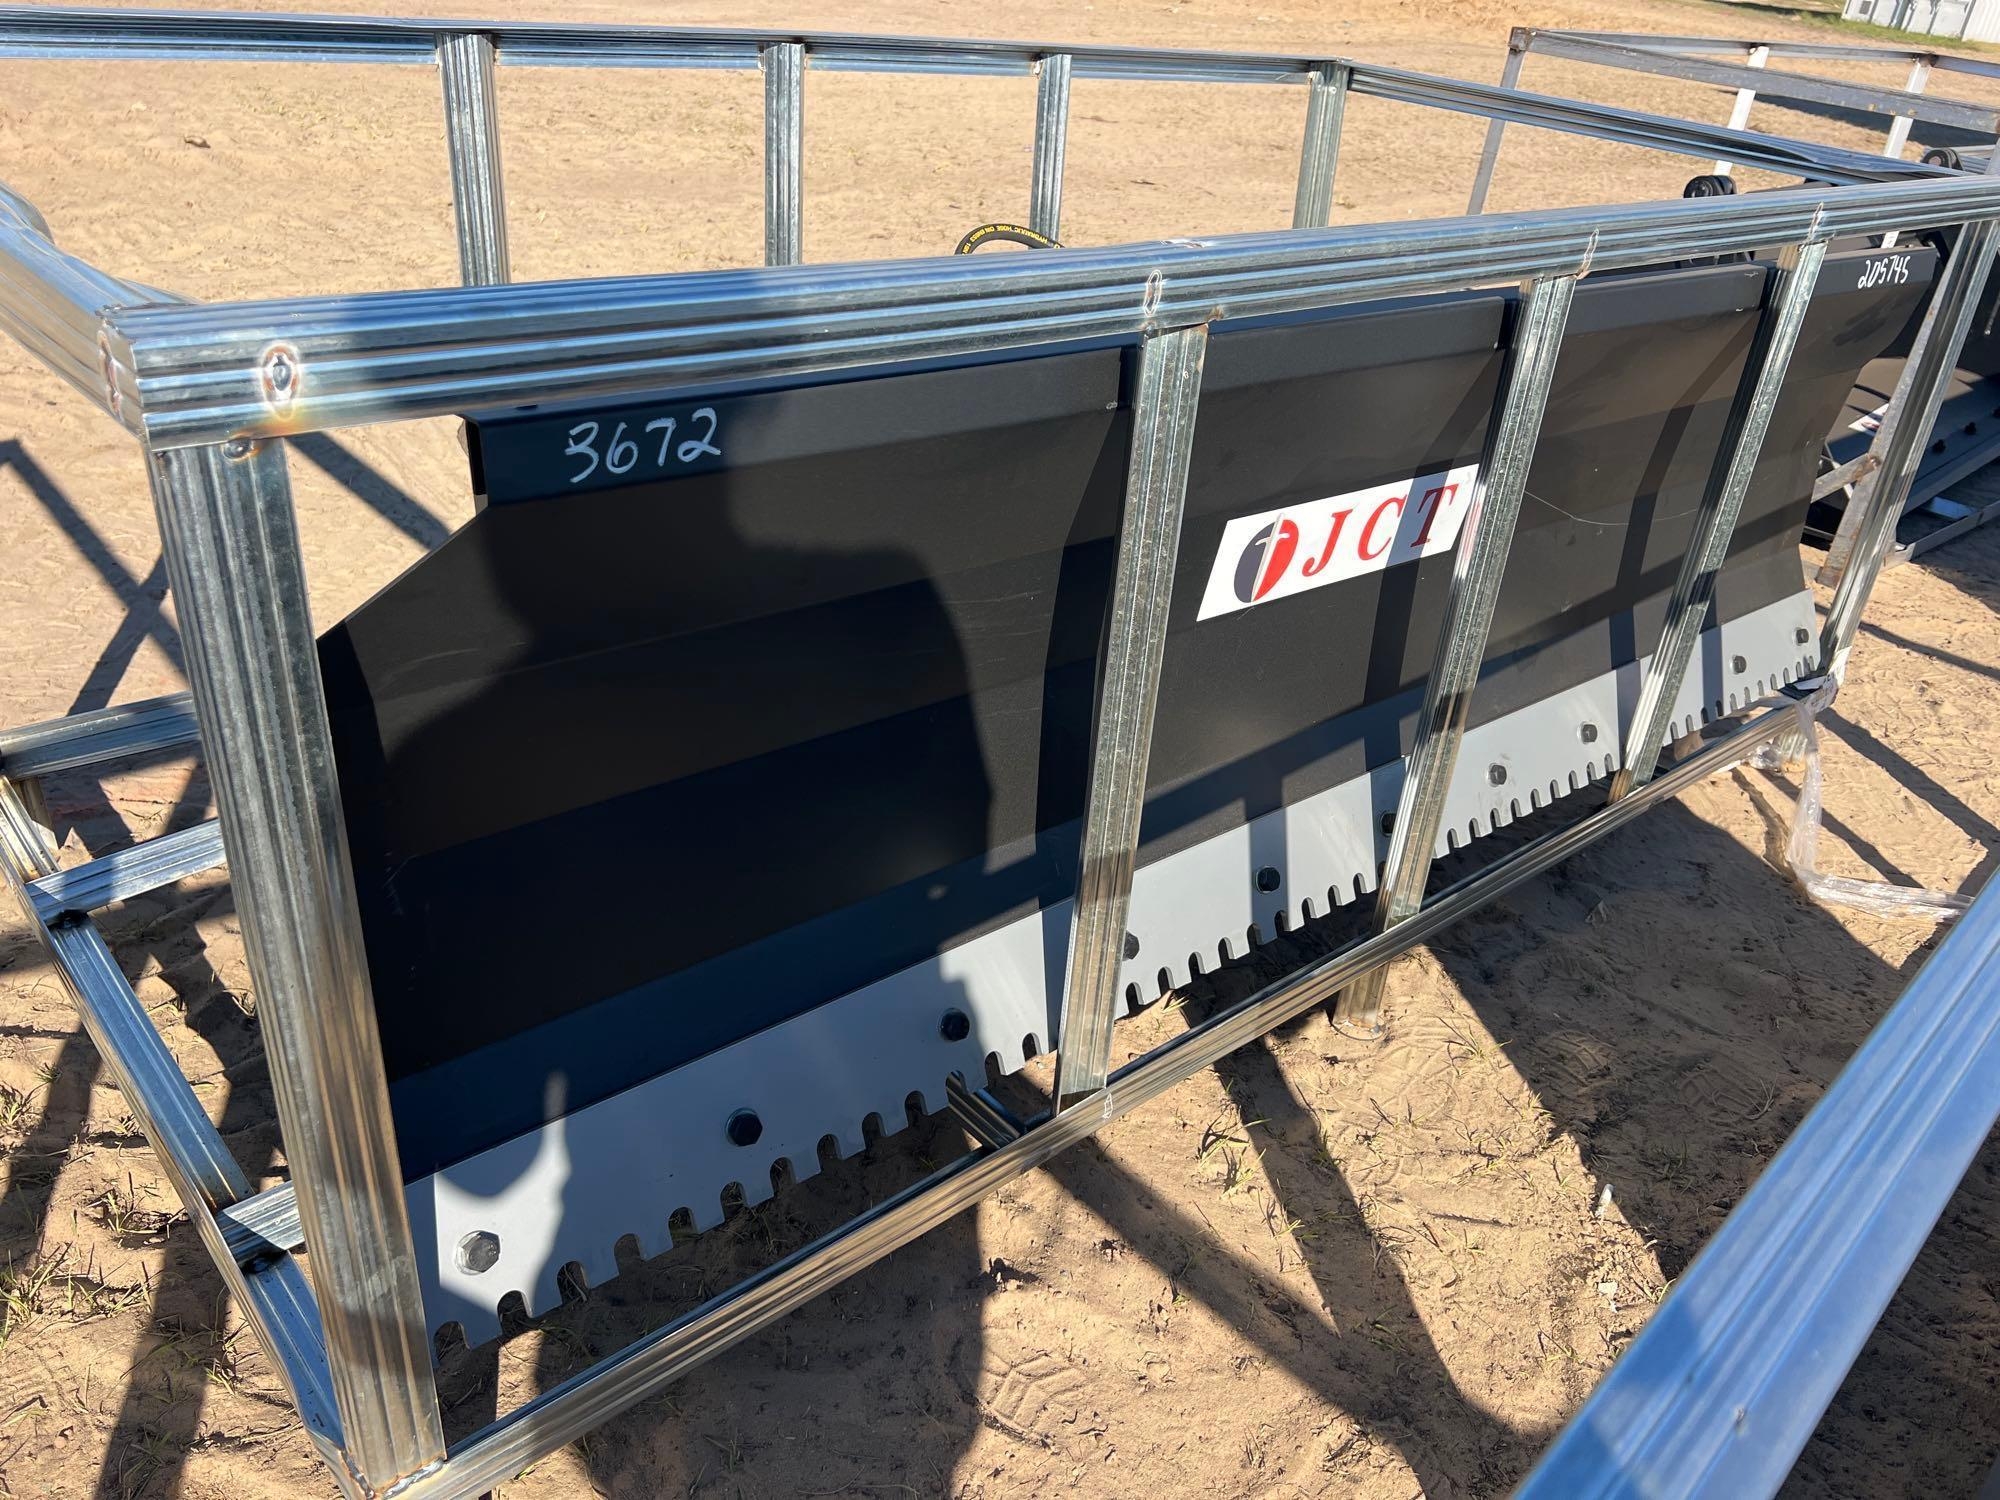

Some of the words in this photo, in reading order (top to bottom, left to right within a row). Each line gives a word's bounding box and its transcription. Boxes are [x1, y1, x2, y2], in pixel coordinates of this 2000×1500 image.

[996, 225, 1012, 233] HOSE
[1014, 226, 1048, 244] HYDRAULIC
[1857, 254, 1911, 289] 205745
[564, 407, 722, 483] 3672
[1301, 483, 1460, 578] JCT
